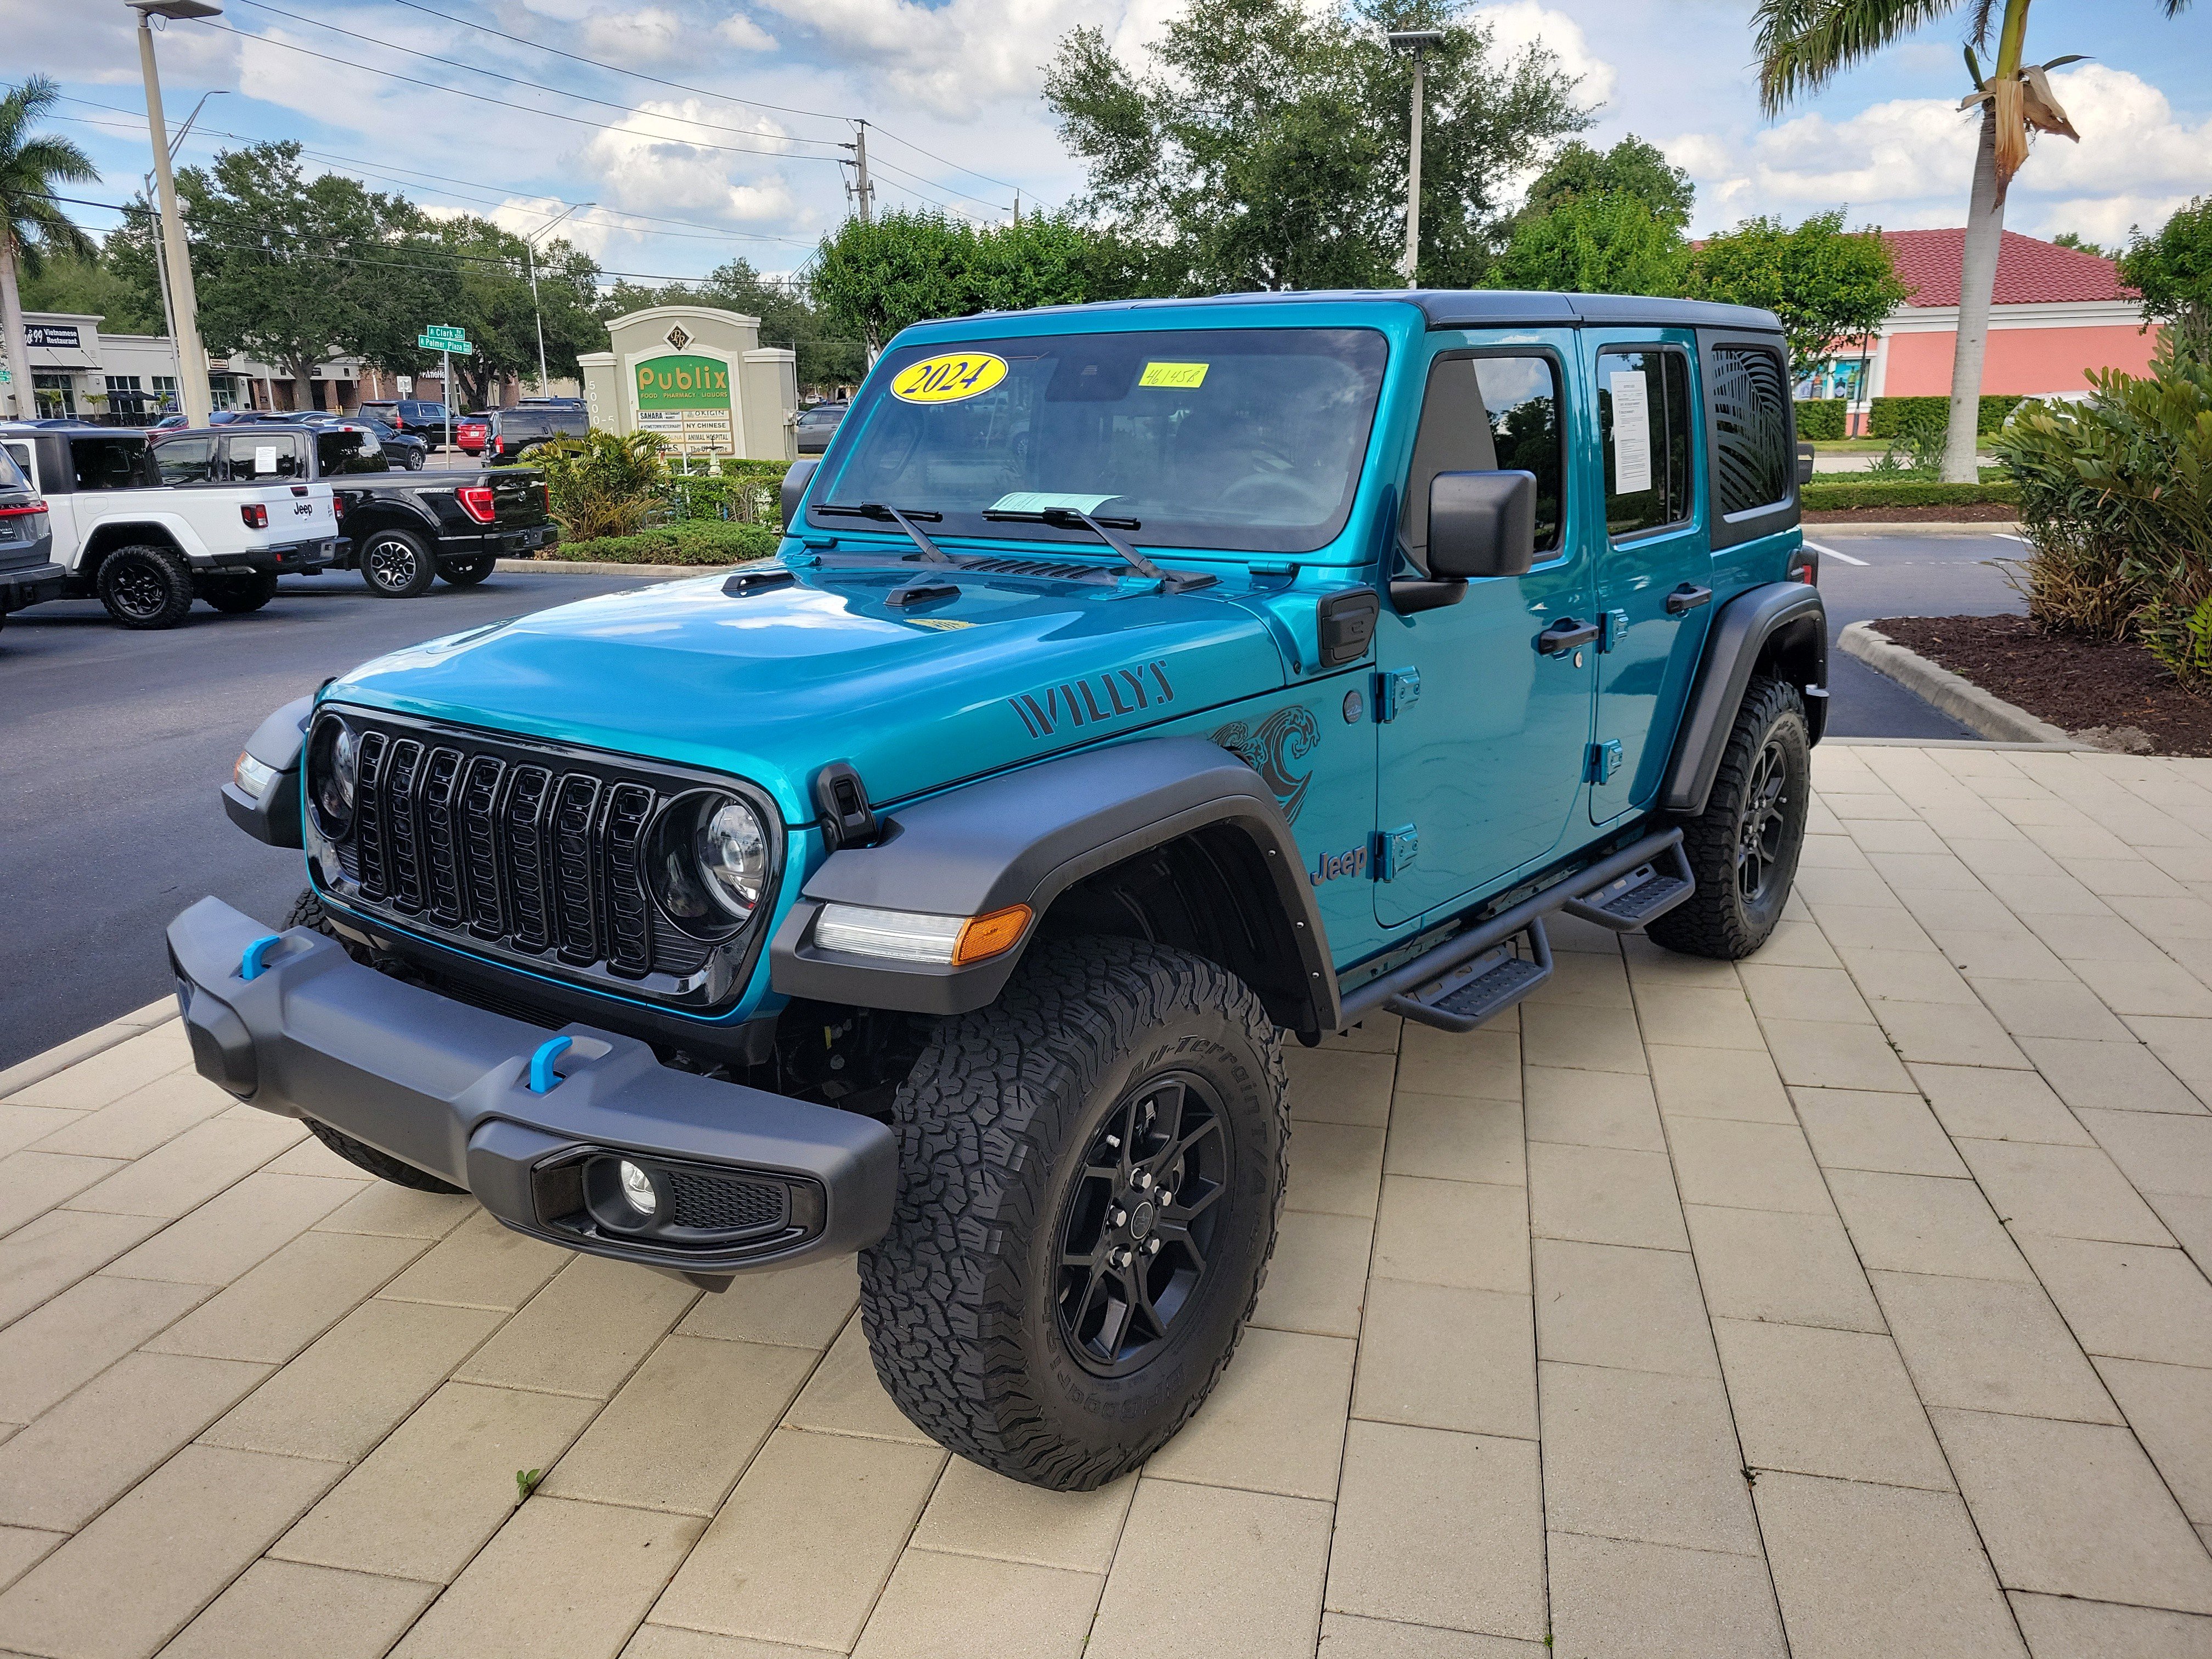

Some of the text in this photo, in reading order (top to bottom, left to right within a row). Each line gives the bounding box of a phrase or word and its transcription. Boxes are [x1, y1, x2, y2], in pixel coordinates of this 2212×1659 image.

[43, 329, 77, 337] Vietnamese
[425, 338, 445, 348] Palmer
[448, 341, 462, 351] Plaza
[436, 329, 453, 337] Clark
[639, 366, 727, 390] Publix
[901, 359, 992, 394] 2024
[294, 501, 313, 516] Jeep
[1007, 659, 1175, 740] WILLYS
[1310, 845, 1368, 887] Jeep
[1121, 1034, 1261, 1116] All-Terrain
